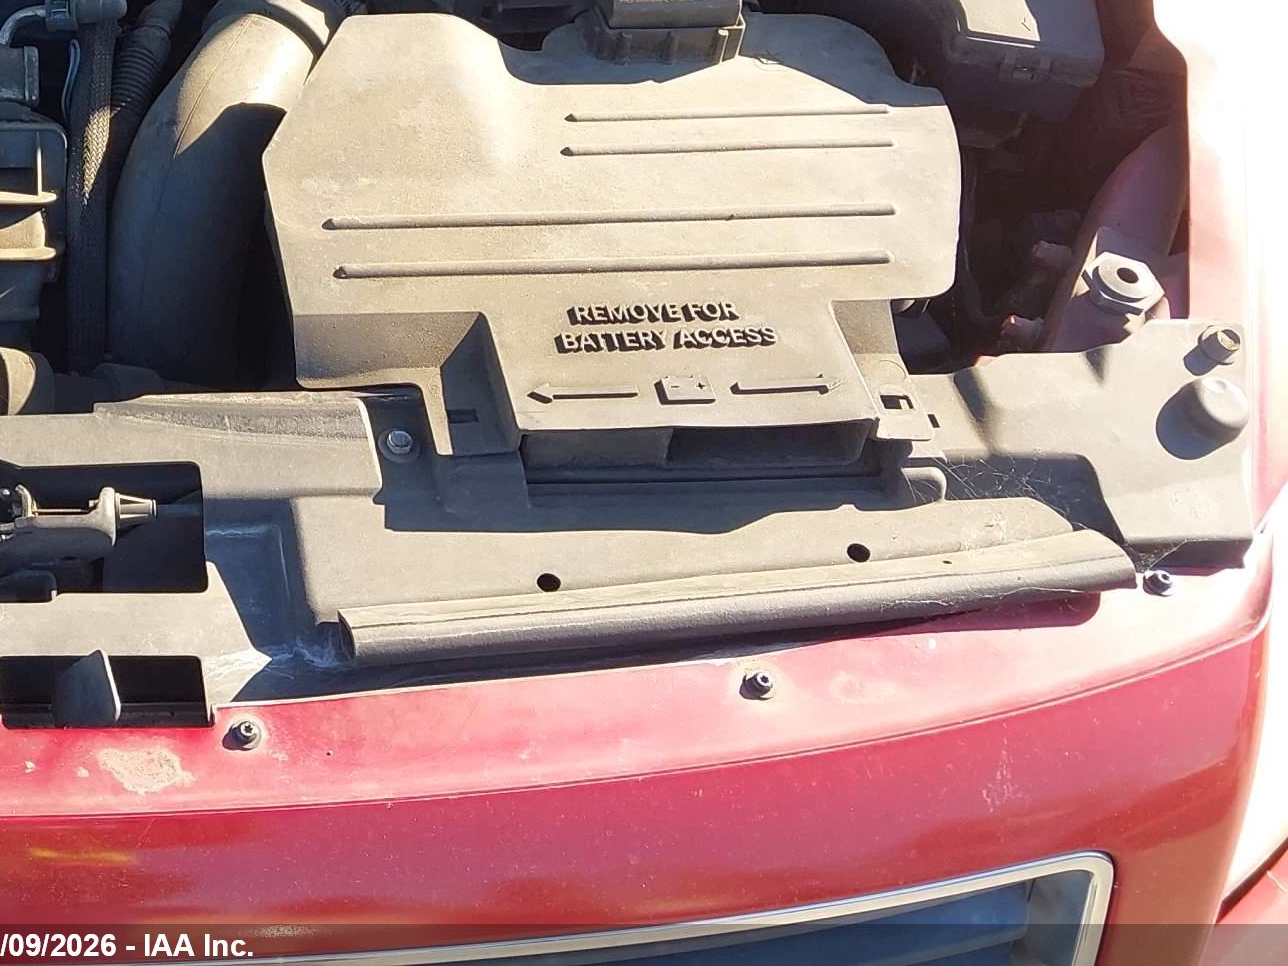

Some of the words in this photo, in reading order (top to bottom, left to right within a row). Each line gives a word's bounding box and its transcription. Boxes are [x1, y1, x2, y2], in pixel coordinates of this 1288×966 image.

[567, 302, 683, 326] REMOVE
[682, 300, 740, 323] FOR
[554, 330, 667, 354] BATTERY
[673, 326, 778, 350] ACCESS
